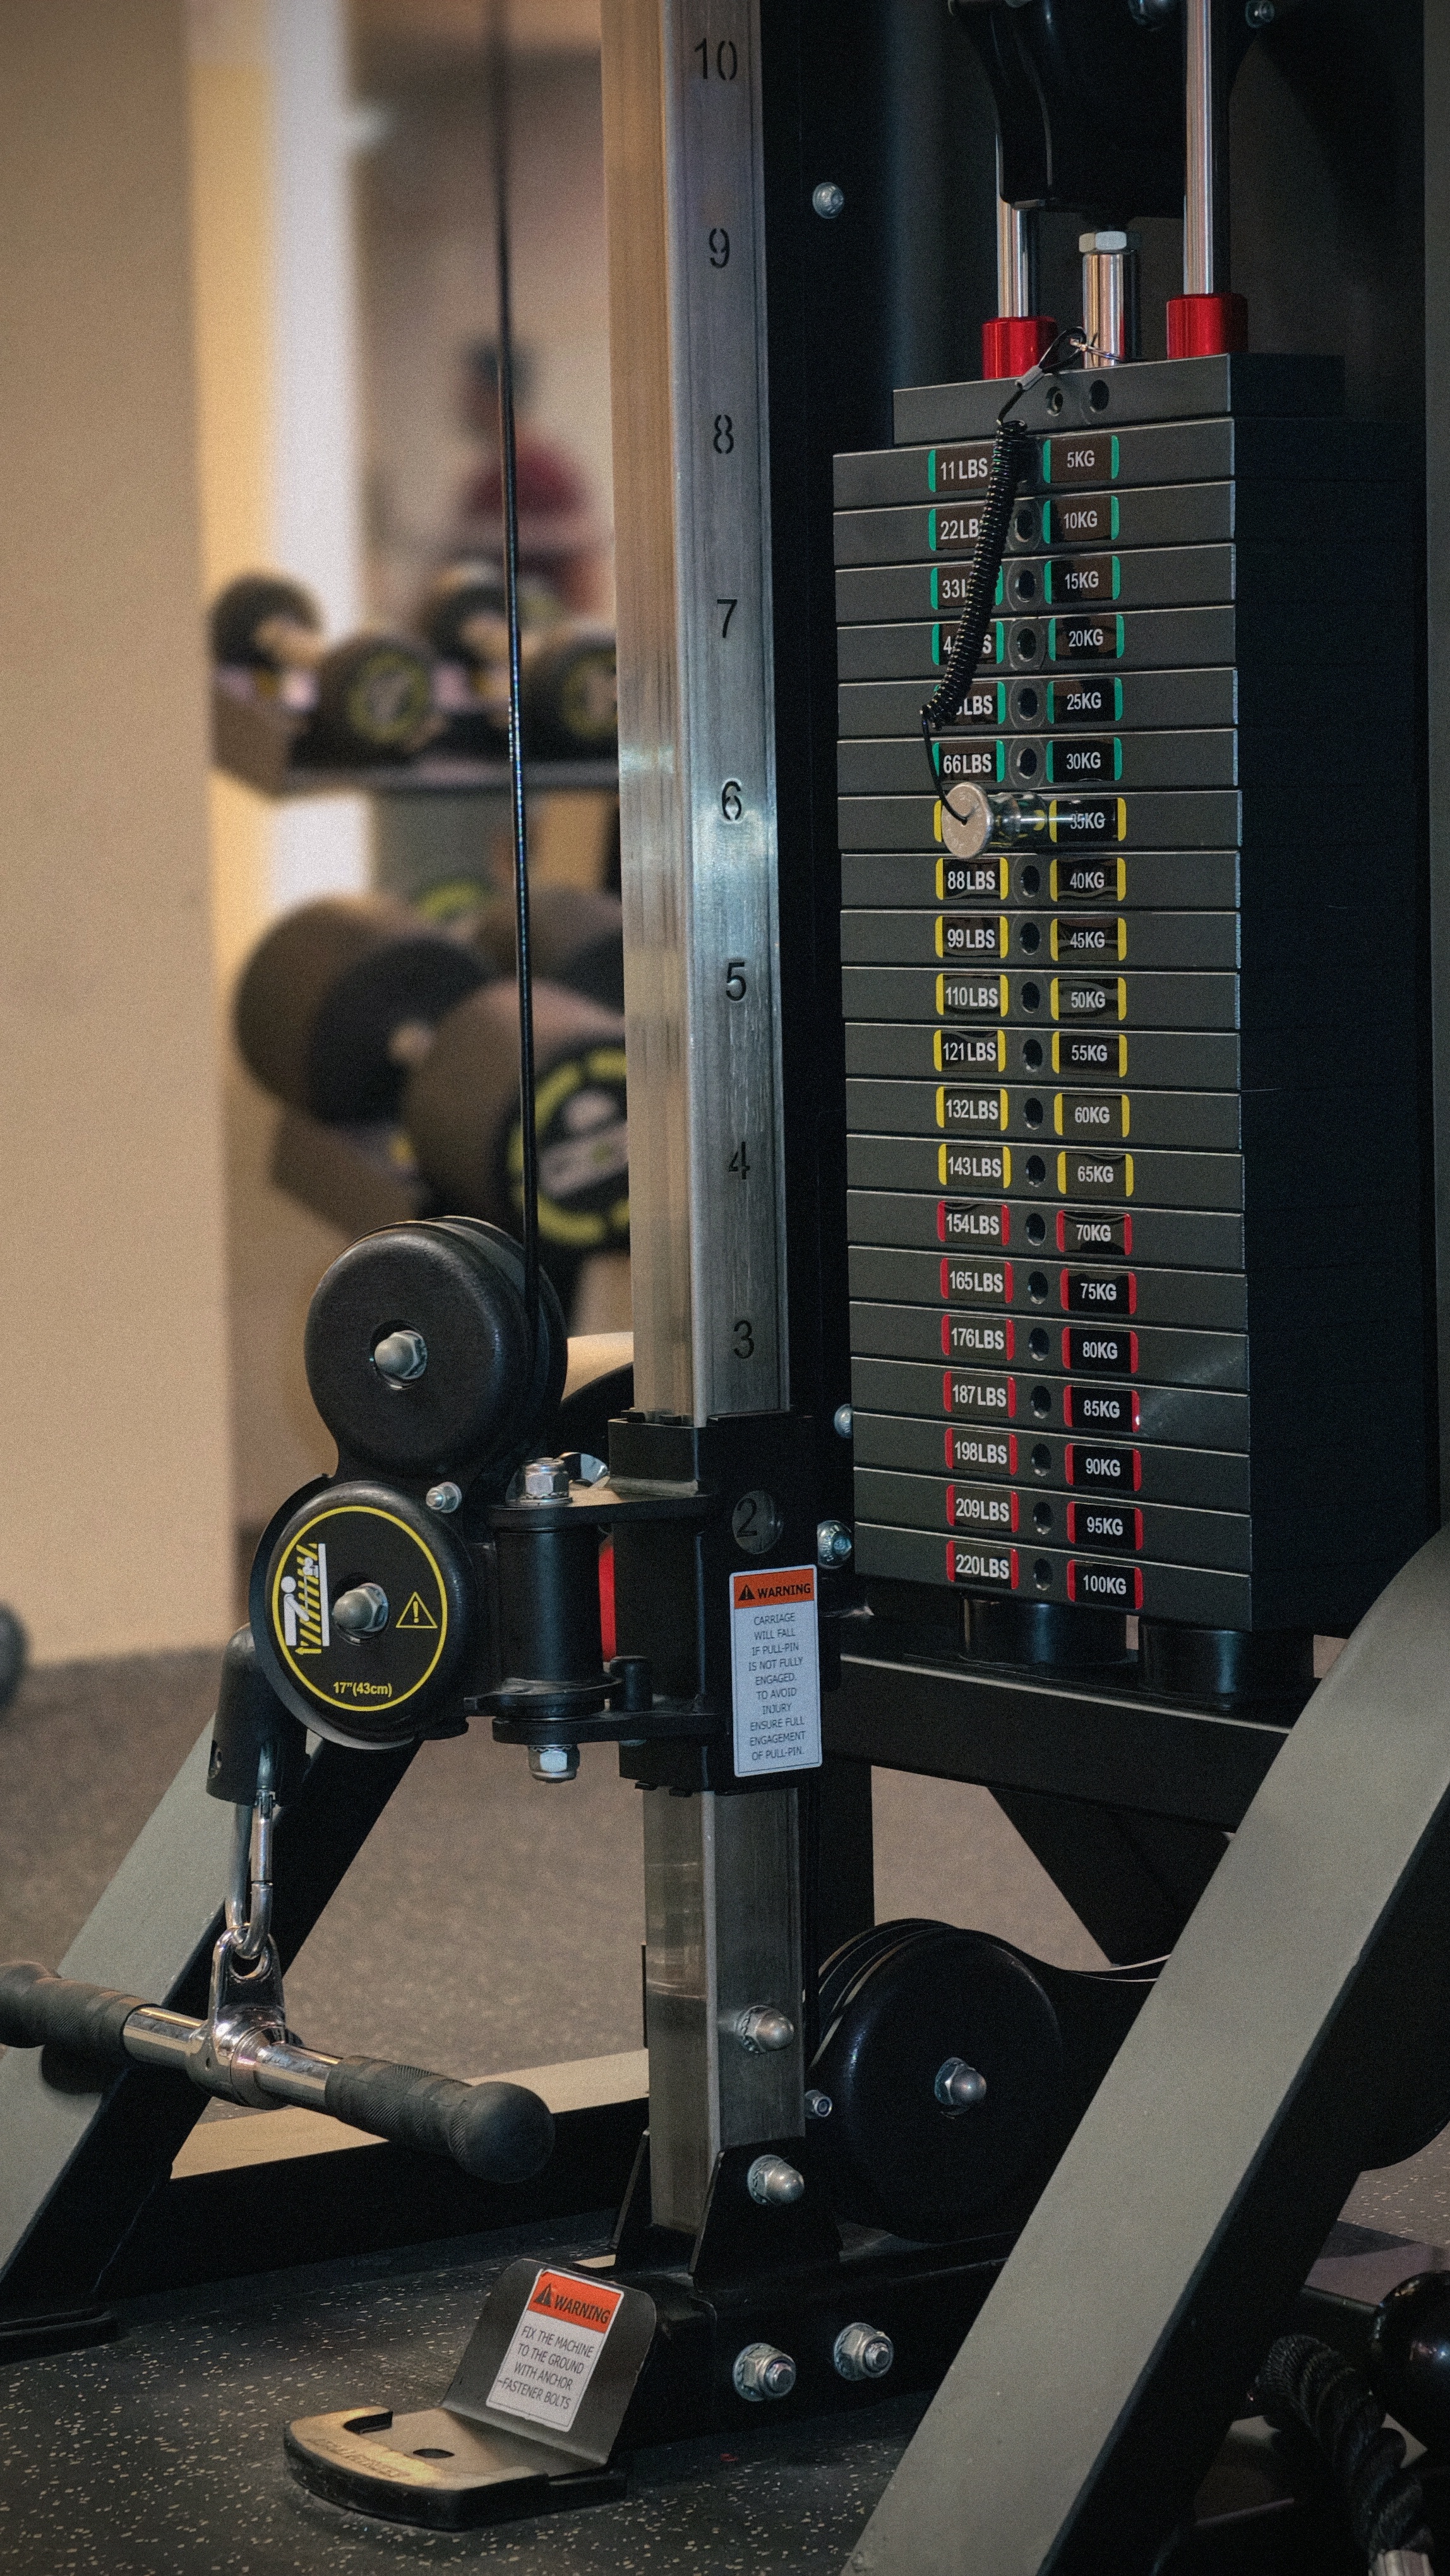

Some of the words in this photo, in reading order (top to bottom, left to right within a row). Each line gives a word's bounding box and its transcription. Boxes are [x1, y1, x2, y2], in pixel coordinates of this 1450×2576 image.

[695, 38, 738, 80] 10
[708, 227, 731, 268] 9
[713, 414, 734, 455] 8
[940, 457, 988, 480] 11LBS
[1067, 450, 1095, 468] 5KG
[940, 518, 980, 540] 22LB
[1064, 510, 1098, 529] 10KG
[1065, 570, 1099, 589] 15KG
[717, 599, 738, 638] 7
[1069, 628, 1104, 647] 20KG
[956, 695, 993, 715] LBS
[1067, 691, 1101, 710] 25KG
[943, 753, 992, 774] 66LBS
[1066, 751, 1101, 770] 30KG
[721, 780, 742, 821] 6
[1069, 812, 1106, 830] 35KG
[947, 870, 995, 890] 88LBS
[1070, 871, 1105, 889] 40KG
[947, 929, 995, 948] 99LBS
[1069, 931, 1105, 948] 45KG
[726, 962, 746, 1001] 5
[945, 986, 998, 1008] 110LBS
[1070, 991, 1106, 1008] 50KG
[943, 1042, 997, 1062] 121LBS
[1071, 1044, 1108, 1062] 55KG
[946, 1099, 998, 1120] 132LBS
[1074, 1106, 1110, 1124] 60KG
[728, 1141, 750, 1179] 4
[947, 1156, 1002, 1178] 143LBS
[1077, 1166, 1114, 1183] 65KG
[946, 1213, 1000, 1236] 154LBS
[1076, 1224, 1111, 1242] 70KG
[949, 1270, 1004, 1293] 165LBS
[1080, 1282, 1117, 1301] 75KG
[733, 1320, 755, 1359] 3
[951, 1327, 1004, 1350] 176LBS
[1082, 1341, 1118, 1359] 80KG
[952, 1385, 1007, 1407] 187LBS
[1083, 1399, 1120, 1419] 85KG
[954, 1441, 1007, 1465] 198LBS
[1086, 1458, 1121, 1477] 90KG
[736, 1498, 758, 1538] 2
[956, 1498, 1010, 1522] 209LBS
[1086, 1516, 1123, 1536] 95KG
[956, 1554, 1010, 1580] 220LBS
[757, 1583, 812, 1599] WARNING
[1083, 1575, 1127, 1595] 100KG
[753, 1613, 796, 1626] CARRIAGE
[753, 1630, 776, 1640] WILL
[777, 1628, 796, 1638] FALL
[752, 1646, 760, 1656] IF
[762, 1642, 800, 1654] PULL-PIN
[748, 1662, 757, 1671] IS
[760, 1659, 777, 1669] NOT
[779, 1656, 803, 1667] FULLY
[757, 1690, 769, 1700] TO
[770, 1687, 797, 1698] AVOID
[762, 1702, 793, 1715] INJURY
[750, 1718, 783, 1731] ENSURE
[785, 1715, 805, 1726] FULL
[750, 1731, 806, 1746] ENGAGEMENT
[752, 1751, 764, 1761] OF
[555, 2294, 611, 2323] WARNING
[521, 2325, 537, 2340] FIX
[537, 2330, 555, 2346] THE
[554, 2336, 594, 2358] MACHINE
[518, 2342, 530, 2357] TO
[530, 2347, 548, 2363] THE
[548, 2353, 584, 2374] GROUND
[514, 2361, 538, 2380] WITH
[537, 2370, 573, 2392] ANCHOR
[544, 2390, 572, 2409] BOLTS
